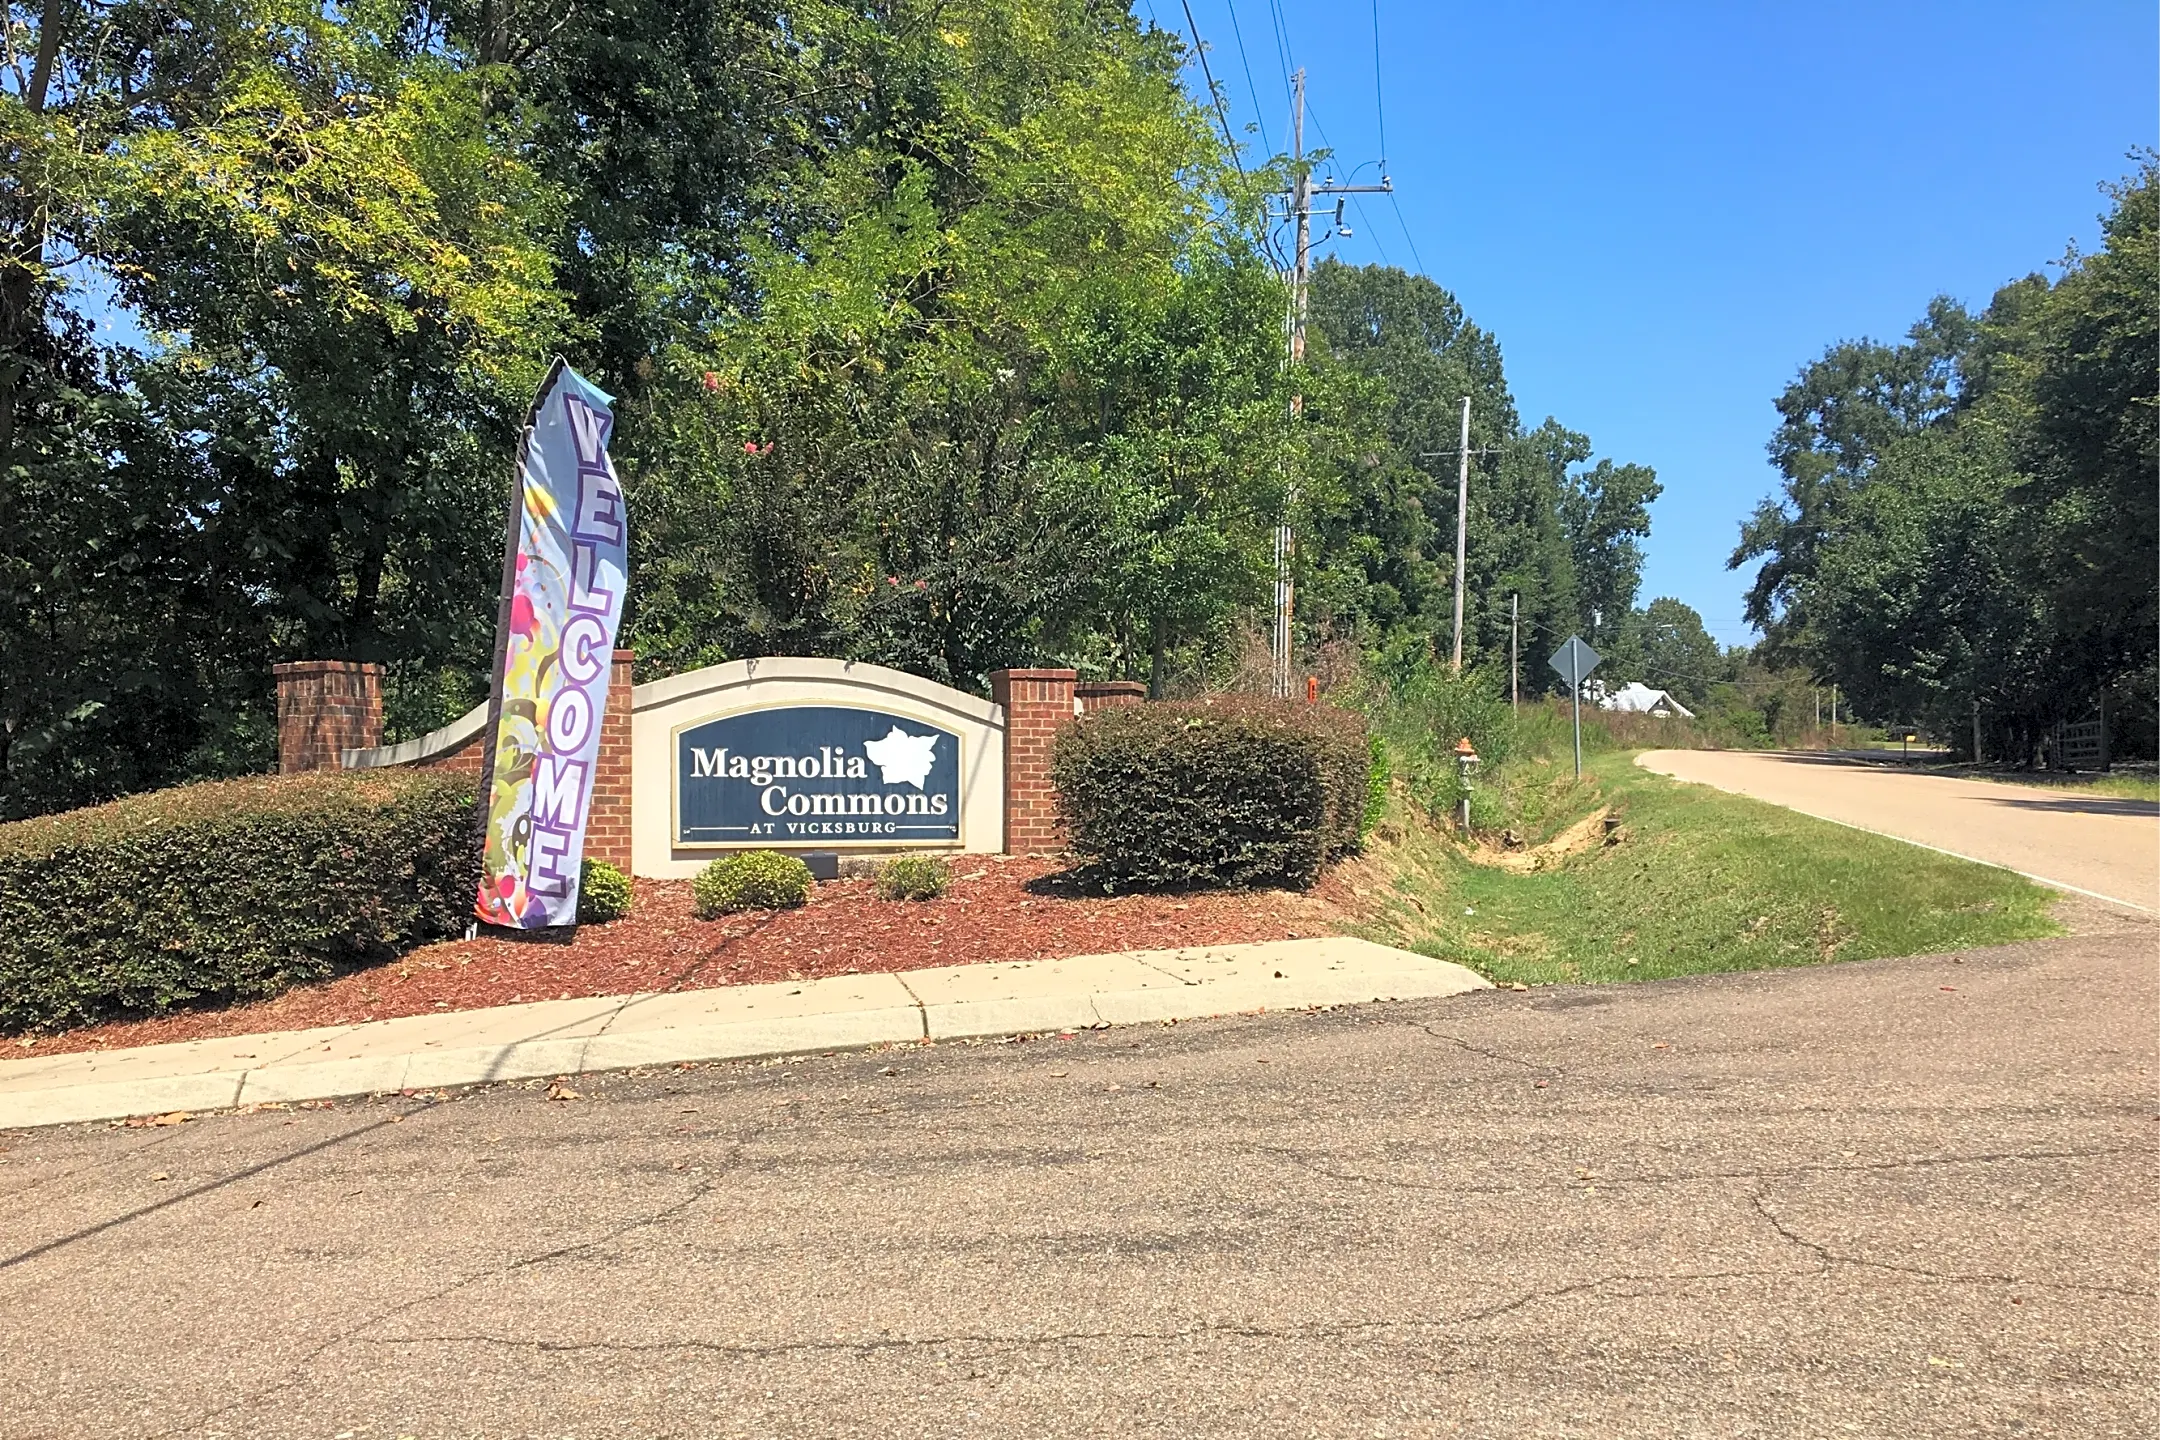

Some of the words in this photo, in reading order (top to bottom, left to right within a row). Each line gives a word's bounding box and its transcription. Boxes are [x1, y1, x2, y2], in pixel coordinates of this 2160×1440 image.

[525, 392, 623, 899] WELCOME
[689, 746, 868, 786] Magnolia
[760, 785, 948, 816] Commons
[749, 822, 775, 834] AT
[786, 822, 896, 834] VICKSBURG
